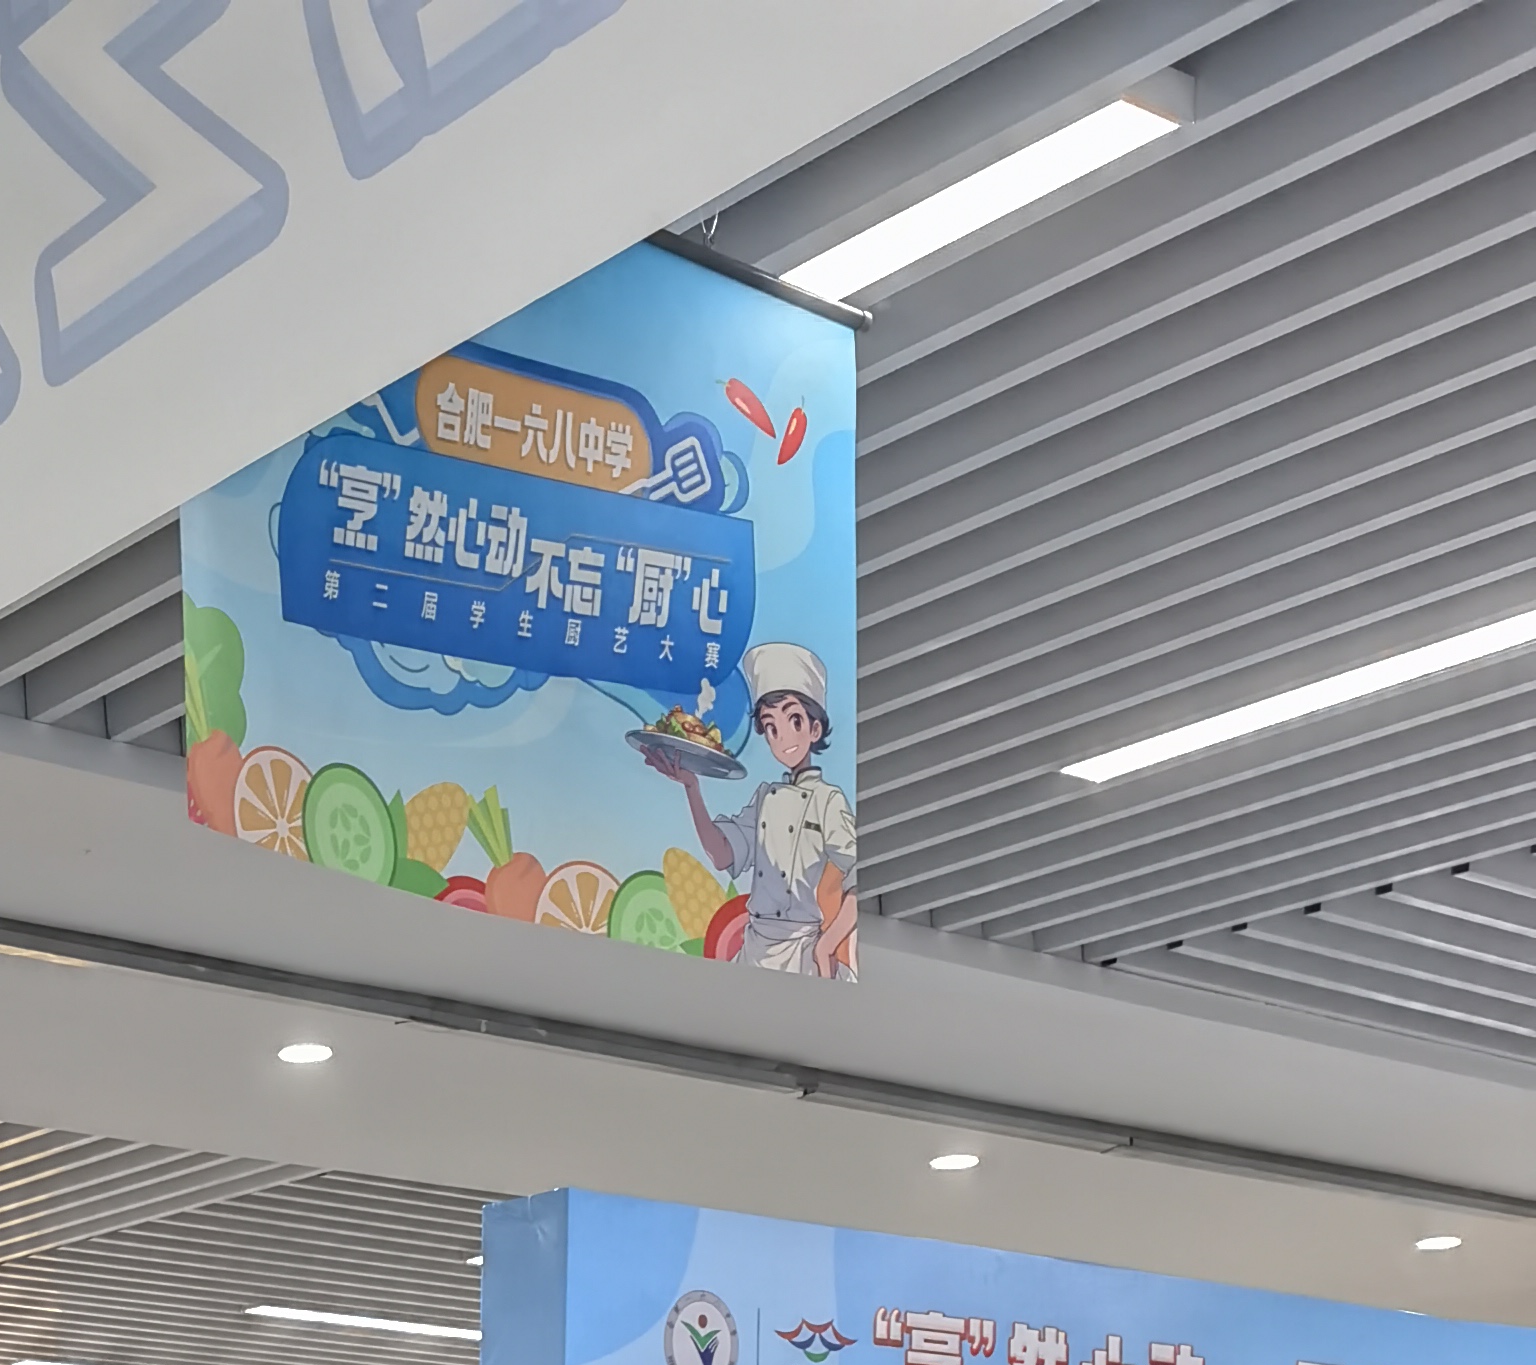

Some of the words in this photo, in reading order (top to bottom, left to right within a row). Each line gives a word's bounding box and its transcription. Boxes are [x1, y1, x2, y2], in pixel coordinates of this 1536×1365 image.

[436, 382, 633, 478] 合肥一六八中学
[323, 570, 721, 669] 第二届学生厨艺大赛
